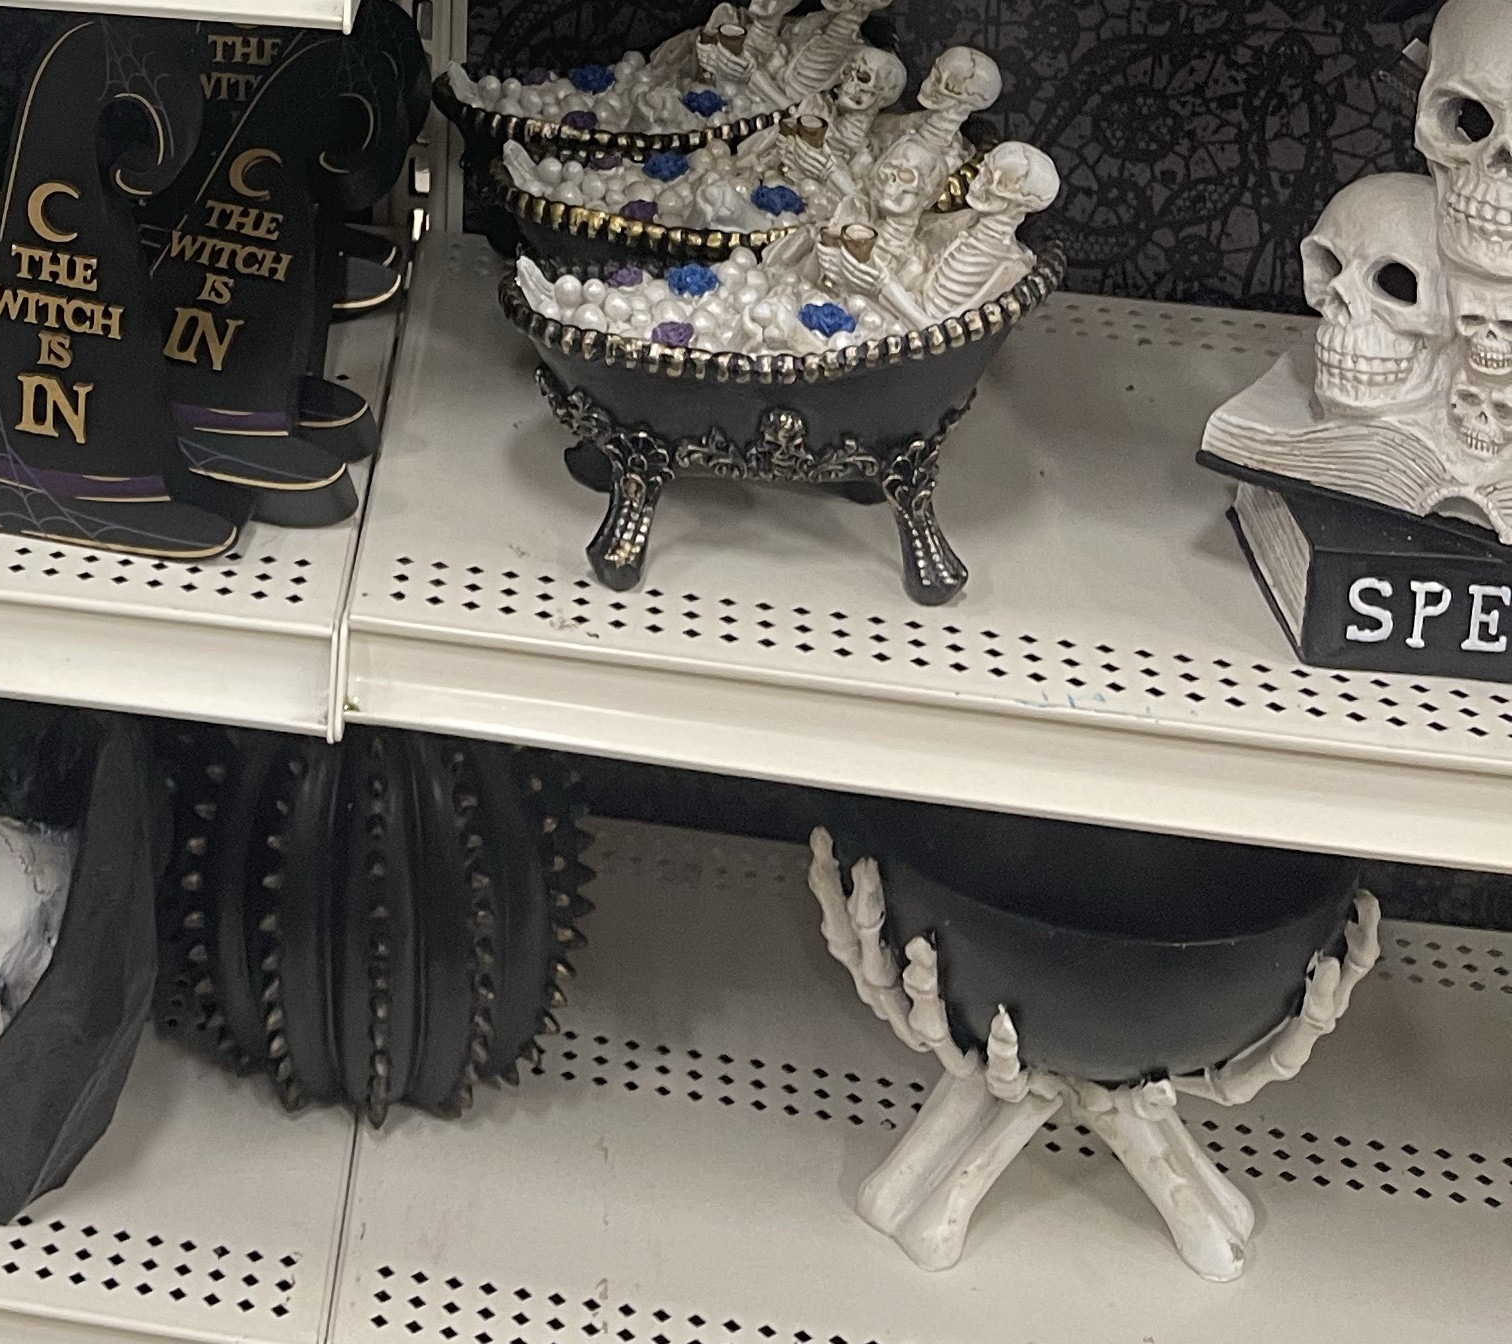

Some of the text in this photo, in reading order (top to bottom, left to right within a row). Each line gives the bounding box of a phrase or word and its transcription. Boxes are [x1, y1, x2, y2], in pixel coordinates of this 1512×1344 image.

[205, 199, 284, 242] THE
[11, 243, 98, 292] THE
[170, 229, 293, 283] WITCH
[197, 272, 235, 305] IS
[37, 329, 74, 369] IS
[163, 307, 245, 372] IN
[14, 372, 94, 445] IN
